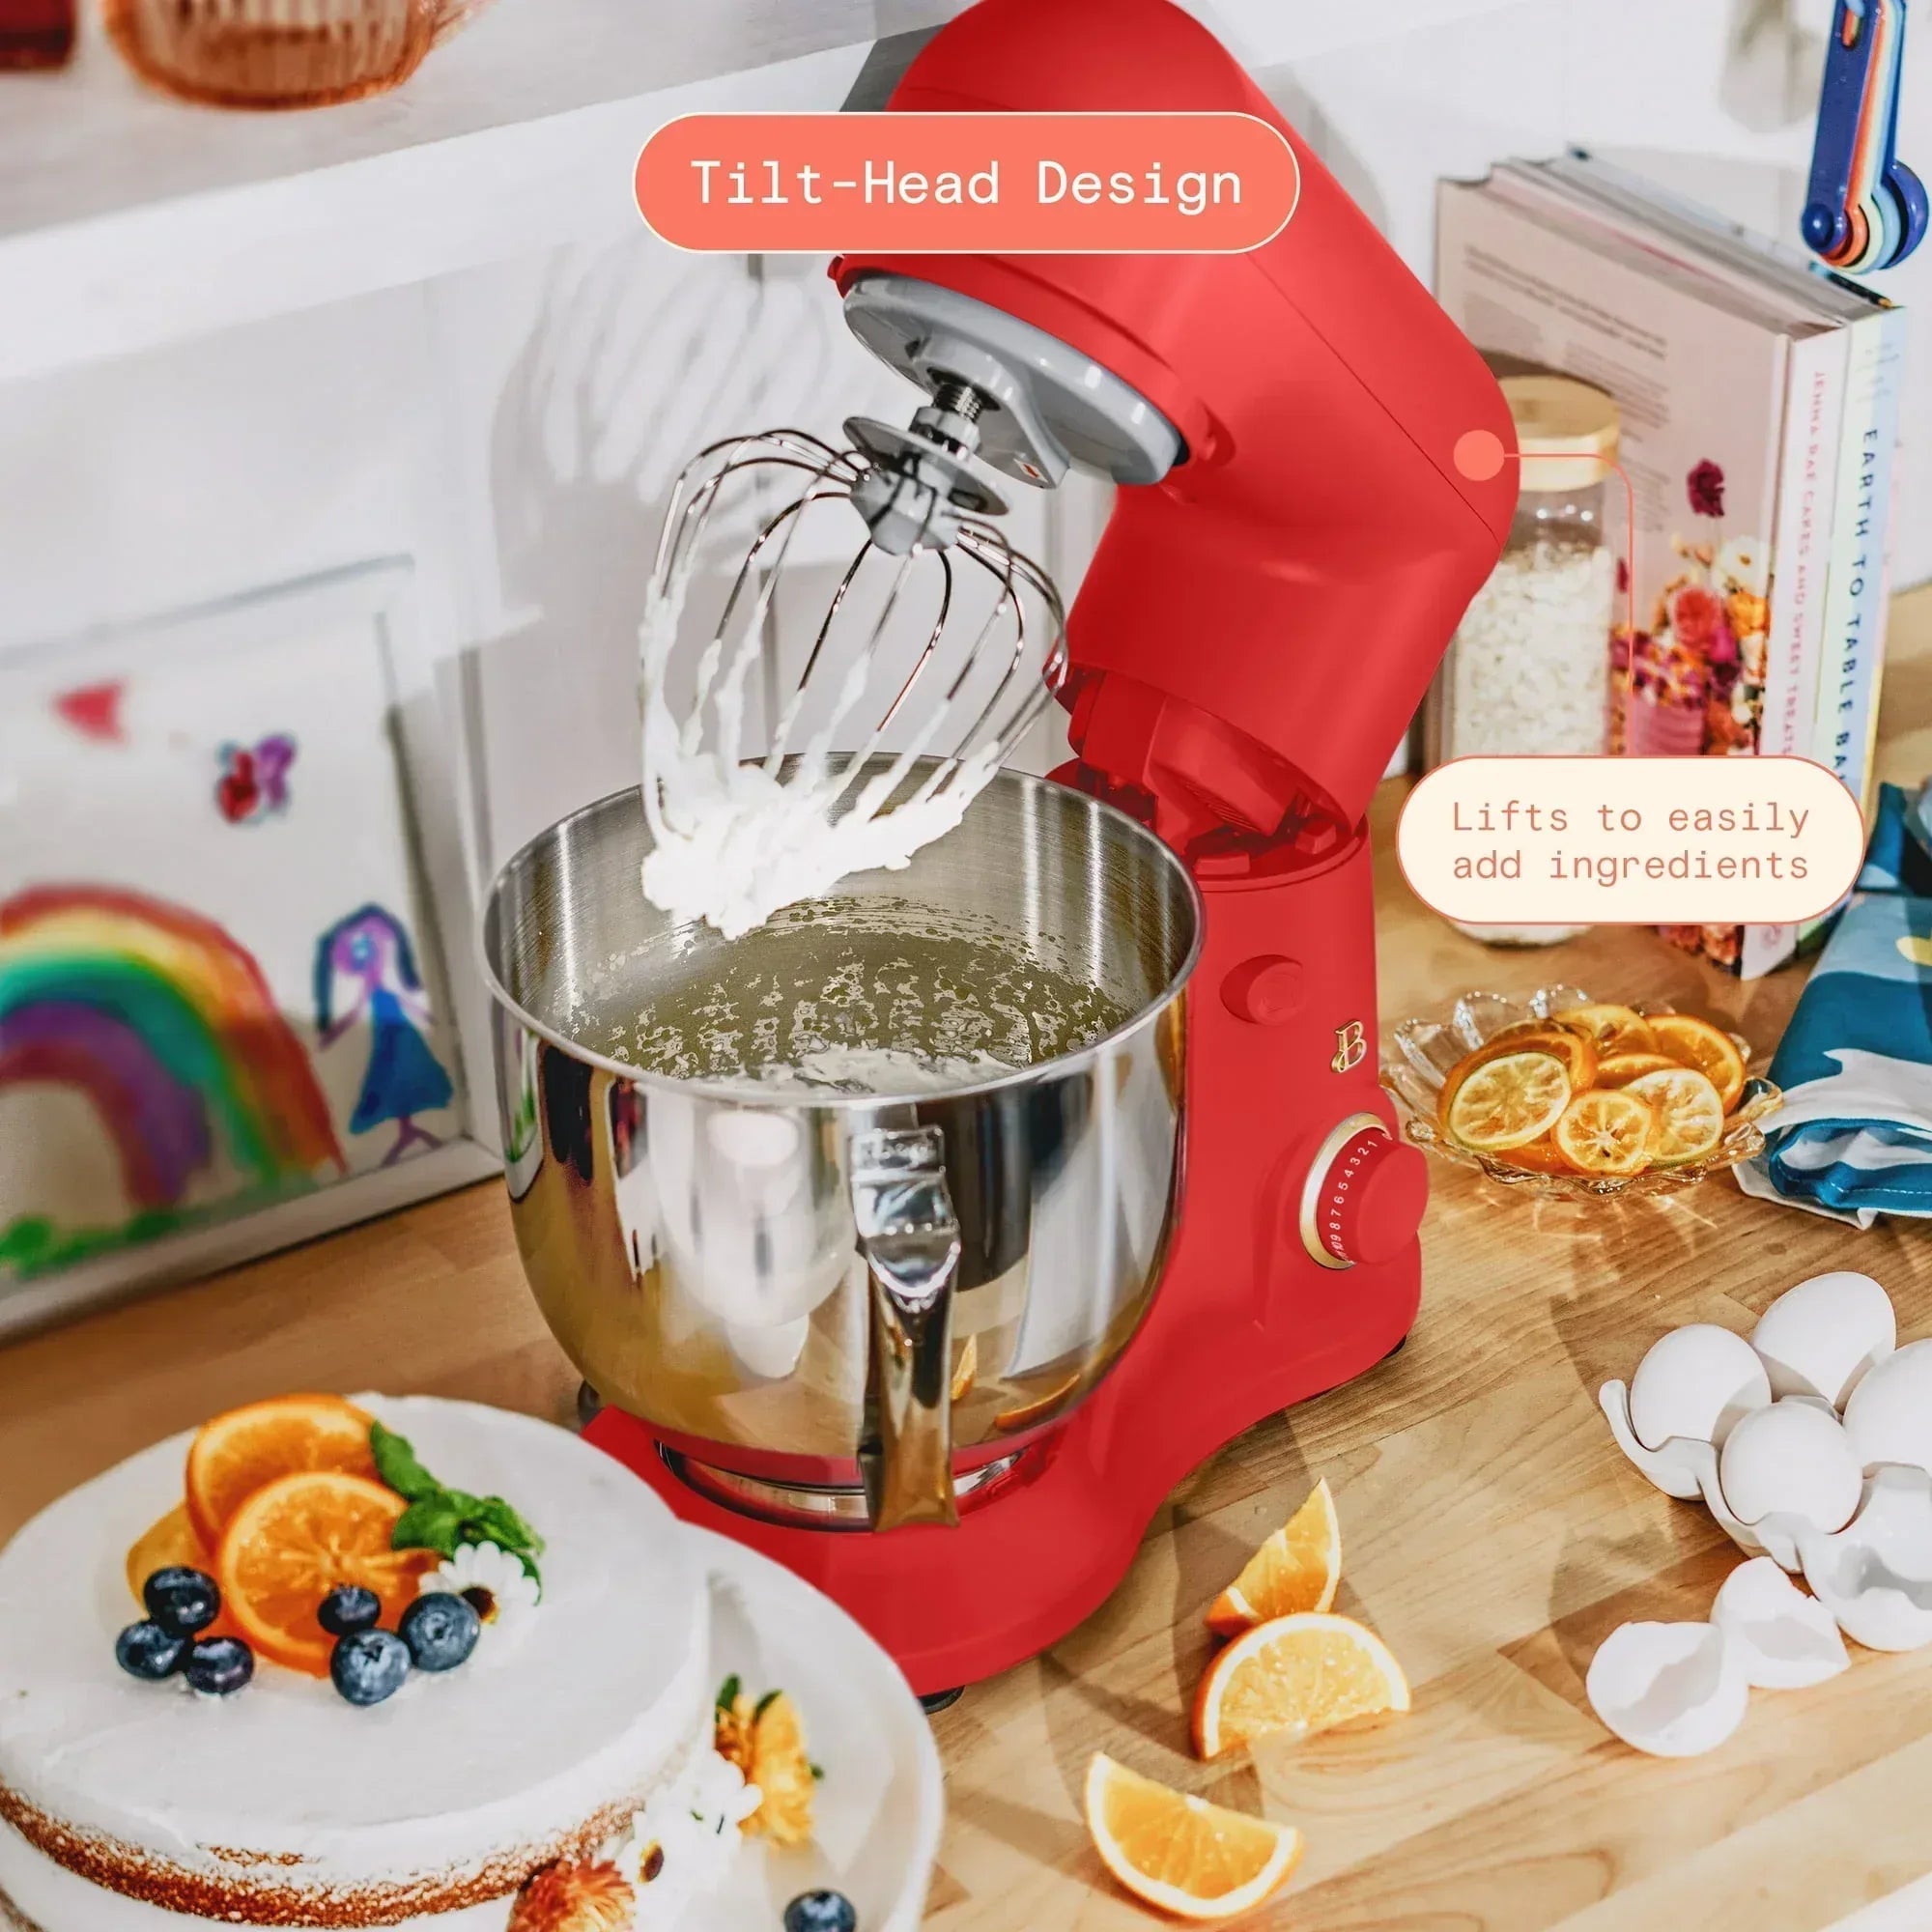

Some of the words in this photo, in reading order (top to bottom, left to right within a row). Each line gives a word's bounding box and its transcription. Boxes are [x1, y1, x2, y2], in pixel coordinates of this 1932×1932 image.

[1854, 429, 1878, 537] EARTH
[1849, 554, 1867, 597] TO
[1837, 612, 1861, 714] TABLE
[1833, 731, 1850, 781] BA
[1357, 1147, 1370, 1155] 2
[1350, 1157, 1361, 1166] 3
[1344, 1169, 1354, 1178] 4
[1337, 1181, 1349, 1191] 5
[1333, 1196, 1345, 1205] 6
[1330, 1208, 1342, 1217] 7
[1329, 1222, 1341, 1231] 8
